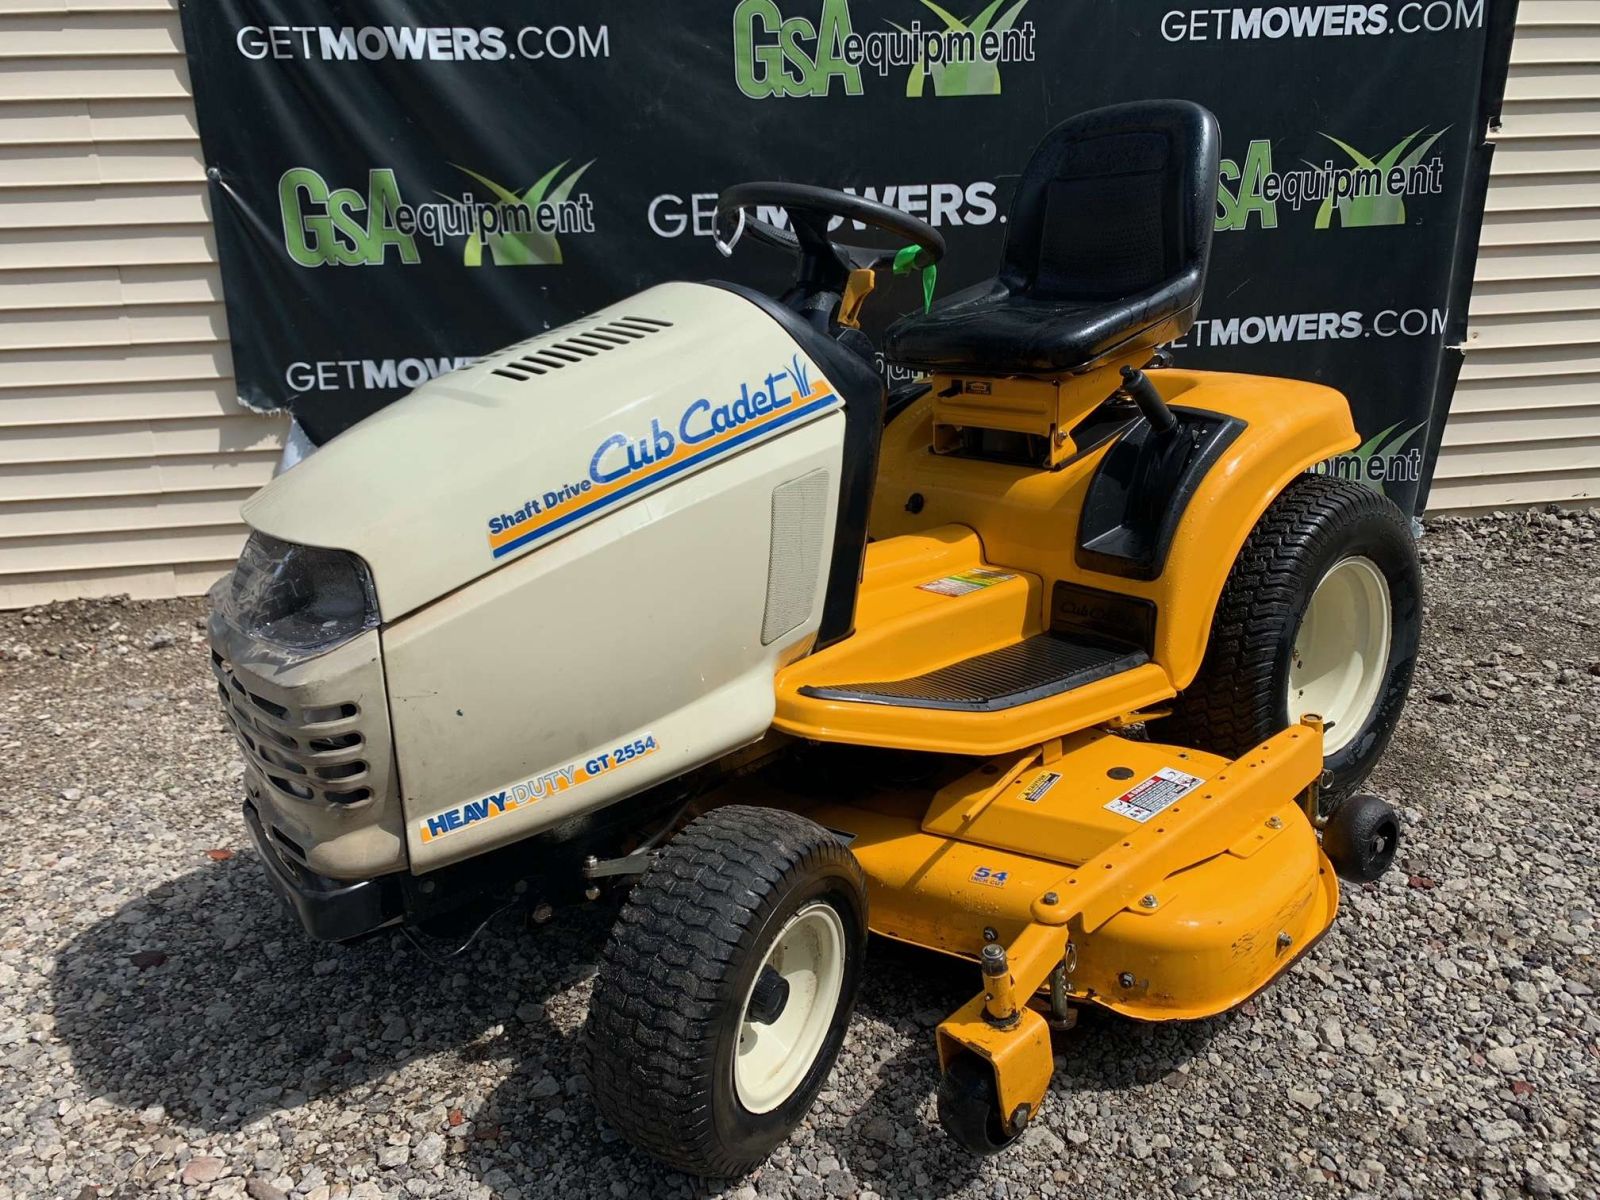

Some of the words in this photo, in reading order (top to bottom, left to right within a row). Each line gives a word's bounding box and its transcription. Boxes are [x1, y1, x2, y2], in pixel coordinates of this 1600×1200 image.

[1161, 0, 1483, 41] GETMOWERS.COM
[236, 25, 610, 61] GETMOWERS.COM
[286, 357, 478, 391] GETMOW
[489, 498, 541, 534] Shaft
[542, 478, 592, 511] Drive
[589, 419, 676, 484] Cub
[679, 372, 791, 443] Cadet
[427, 765, 575, 837] HEAVY-DUTY
[585, 754, 609, 776] GT
[614, 735, 656, 764] 2554
[974, 867, 1008, 881] 54
